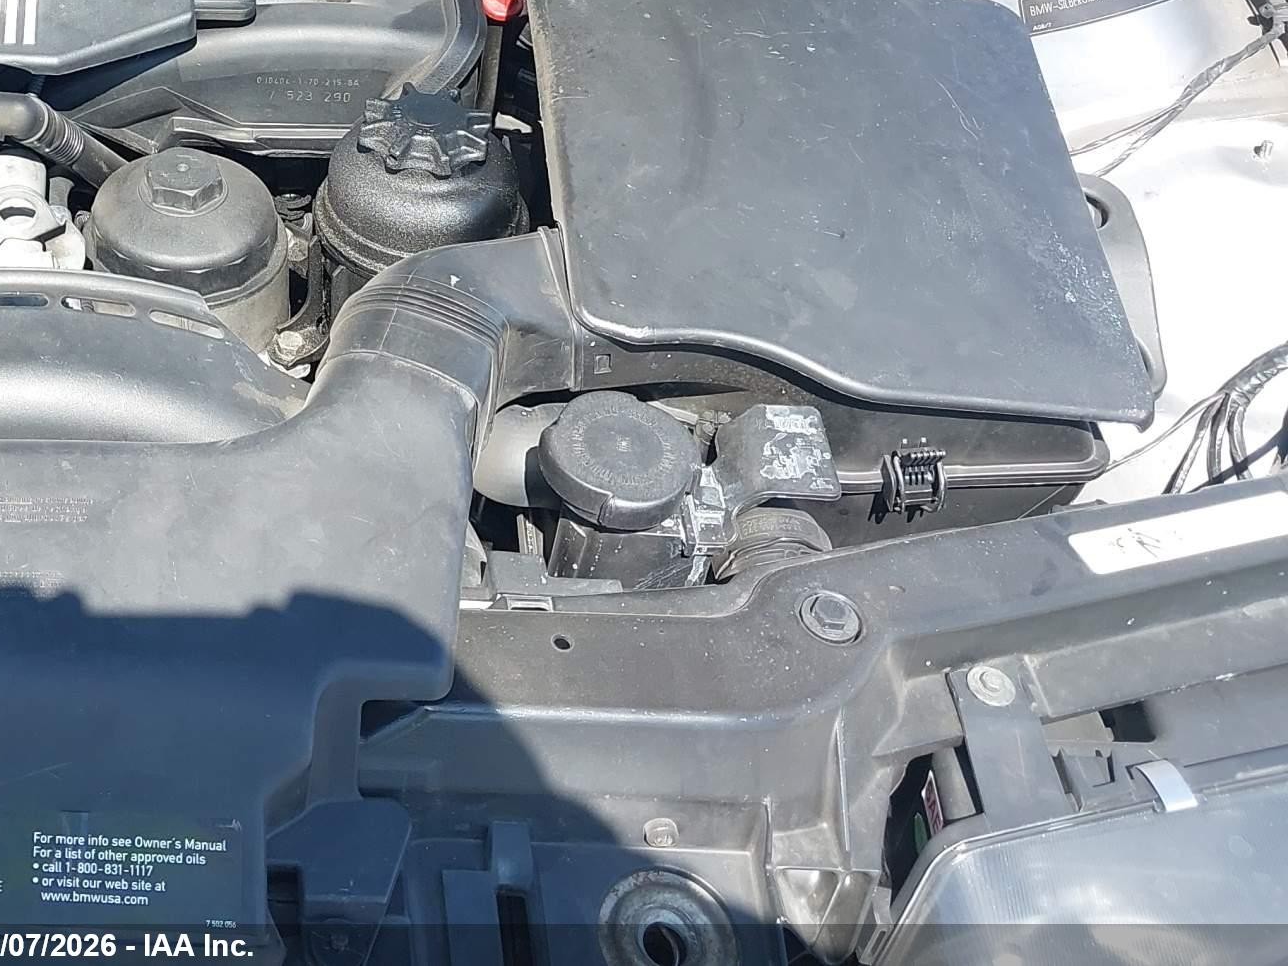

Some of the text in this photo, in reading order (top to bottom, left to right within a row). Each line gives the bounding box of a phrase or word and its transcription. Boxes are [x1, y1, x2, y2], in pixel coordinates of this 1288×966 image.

[287, 90, 313, 102] 523
[324, 92, 351, 103] 290
[33, 832, 227, 851] For more info see Owner's Manual
[33, 846, 207, 865] For a list of other approved oils
[42, 861, 153, 877] call 1-800-831-1117
[41, 877, 166, 892] or visit our web site at
[40, 891, 149, 906] www.bmwusa.com
